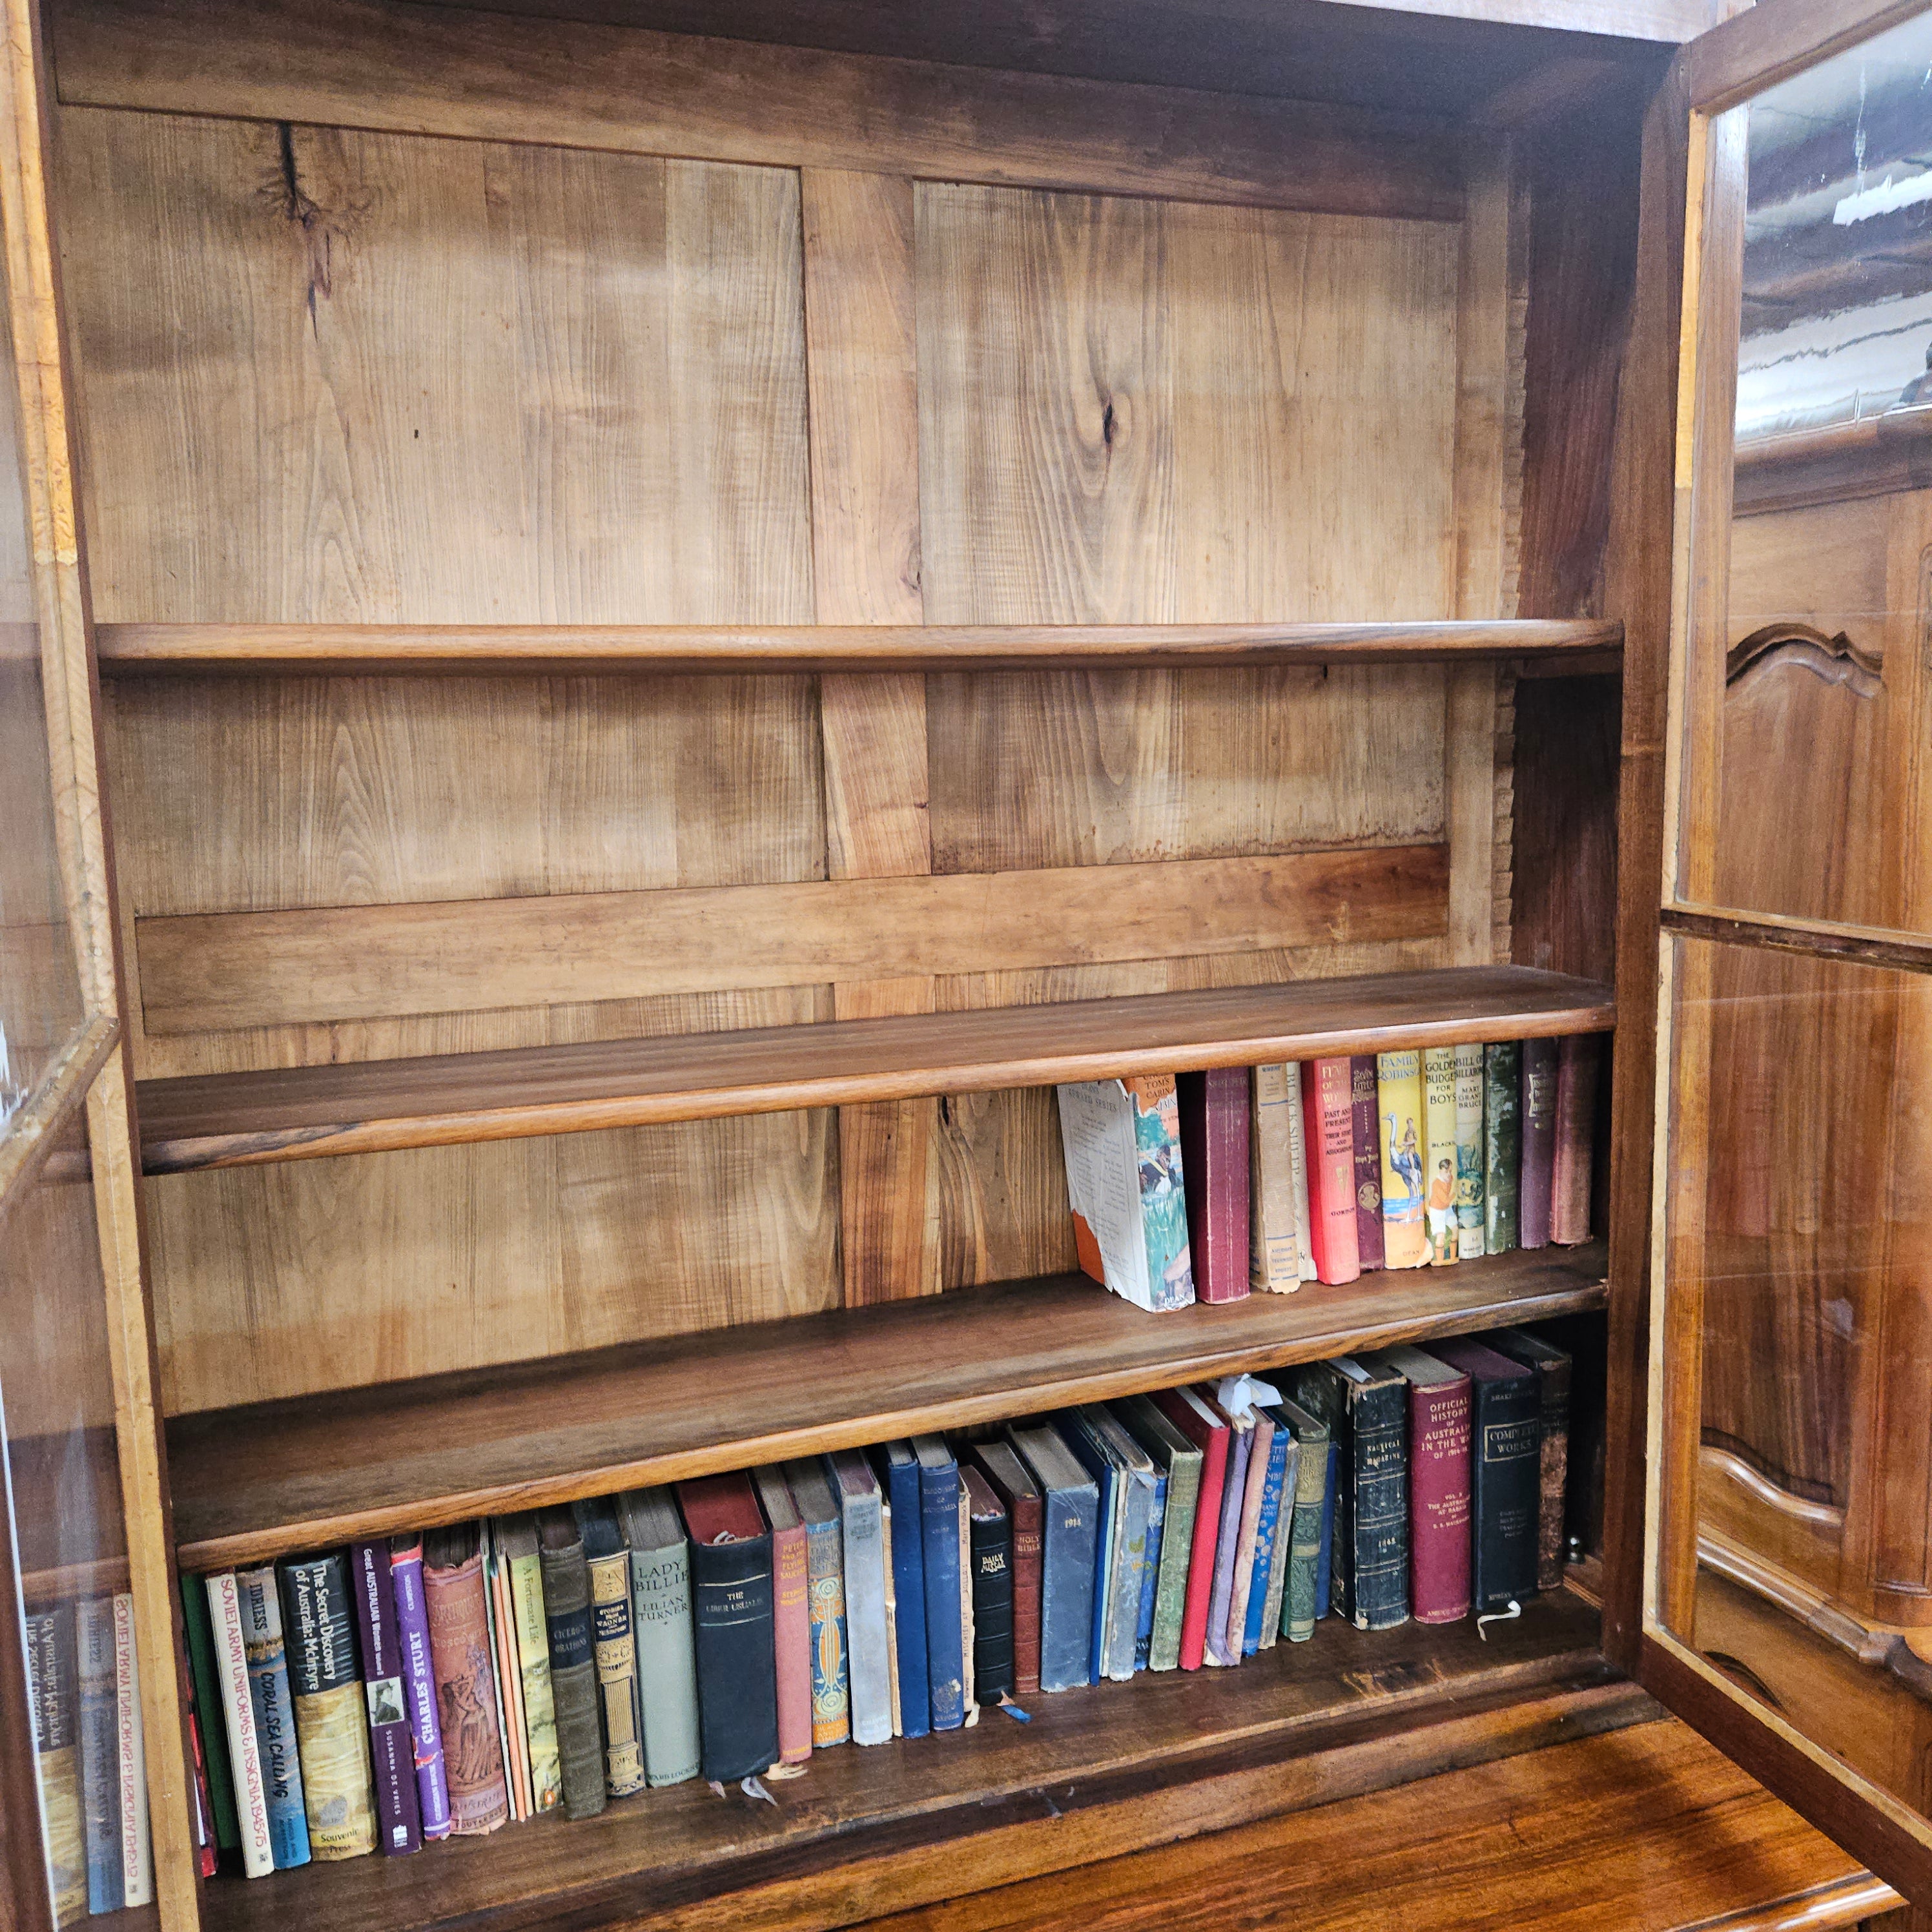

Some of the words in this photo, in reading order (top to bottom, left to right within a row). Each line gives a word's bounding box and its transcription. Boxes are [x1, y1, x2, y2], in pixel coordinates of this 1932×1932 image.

[1381, 1054, 1419, 1069] FAMILY
[1455, 1056, 1474, 1066] BILL
[1426, 1072, 1455, 1084] BUDGE
[1146, 1087, 1170, 1099] CABIN
[1287, 1074, 1297, 1121] BLACK
[1430, 1093, 1456, 1105] BOYS
[1324, 1110, 1340, 1119] PAST
[1325, 1117, 1351, 1127] PRESENT
[1290, 1127, 1300, 1175] SHEEP
[1331, 1207, 1355, 1217] GORDON
[1430, 1397, 1468, 1413] OFFICIAL
[1430, 1406, 1468, 1423] HISTORY
[1366, 1439, 1401, 1453] NAUTICAL
[1421, 1442, 1434, 1452] IN
[1437, 1436, 1456, 1450] THE
[1496, 1438, 1532, 1454] WORKS
[1065, 1517, 1082, 1529] 1914
[783, 1539, 805, 1550] PETER
[1017, 1543, 1042, 1552] BIBLE
[1018, 1536, 1041, 1544] HOLY
[363, 1548, 374, 1570] Great
[781, 1553, 796, 1561] AND
[981, 1552, 1005, 1565] DAILY
[313, 1564, 329, 1588] The
[523, 1567, 531, 1576] A
[638, 1559, 683, 1579] LADY
[635, 1570, 690, 1592] BILLIE
[220, 1578, 238, 1627] SOVIET
[365, 1568, 381, 1623] AUSTRALIAN
[524, 1576, 535, 1624] Fortunate
[642, 1594, 684, 1612] LILIAN
[726, 1591, 744, 1601] THE
[250, 1583, 267, 1631] IDRIESS
[314, 1588, 331, 1626] Secret
[639, 1603, 688, 1622] TURNER
[295, 1569, 311, 1583] of
[303, 1638, 320, 1691] McIntyre
[528, 1626, 541, 1647] Life
[227, 1627, 242, 1664] ARMY
[320, 1625, 336, 1681] Discovery
[409, 1631, 426, 1678] STURT
[232, 1665, 252, 1736] UNIFORMS
[260, 1672, 277, 1716] CORAL
[415, 1681, 435, 1745] CHARLES
[266, 1714, 282, 1741] SEA
[385, 1729, 396, 1772] SUSANNA
[243, 1747, 262, 1805] INSIGNIA
[269, 1744, 289, 1799] CALLING
[390, 1774, 398, 1787] DE
[392, 1789, 402, 1816] VRIES
[320, 1827, 359, 1844] Souvenir
[328, 1844, 352, 1853] Press
